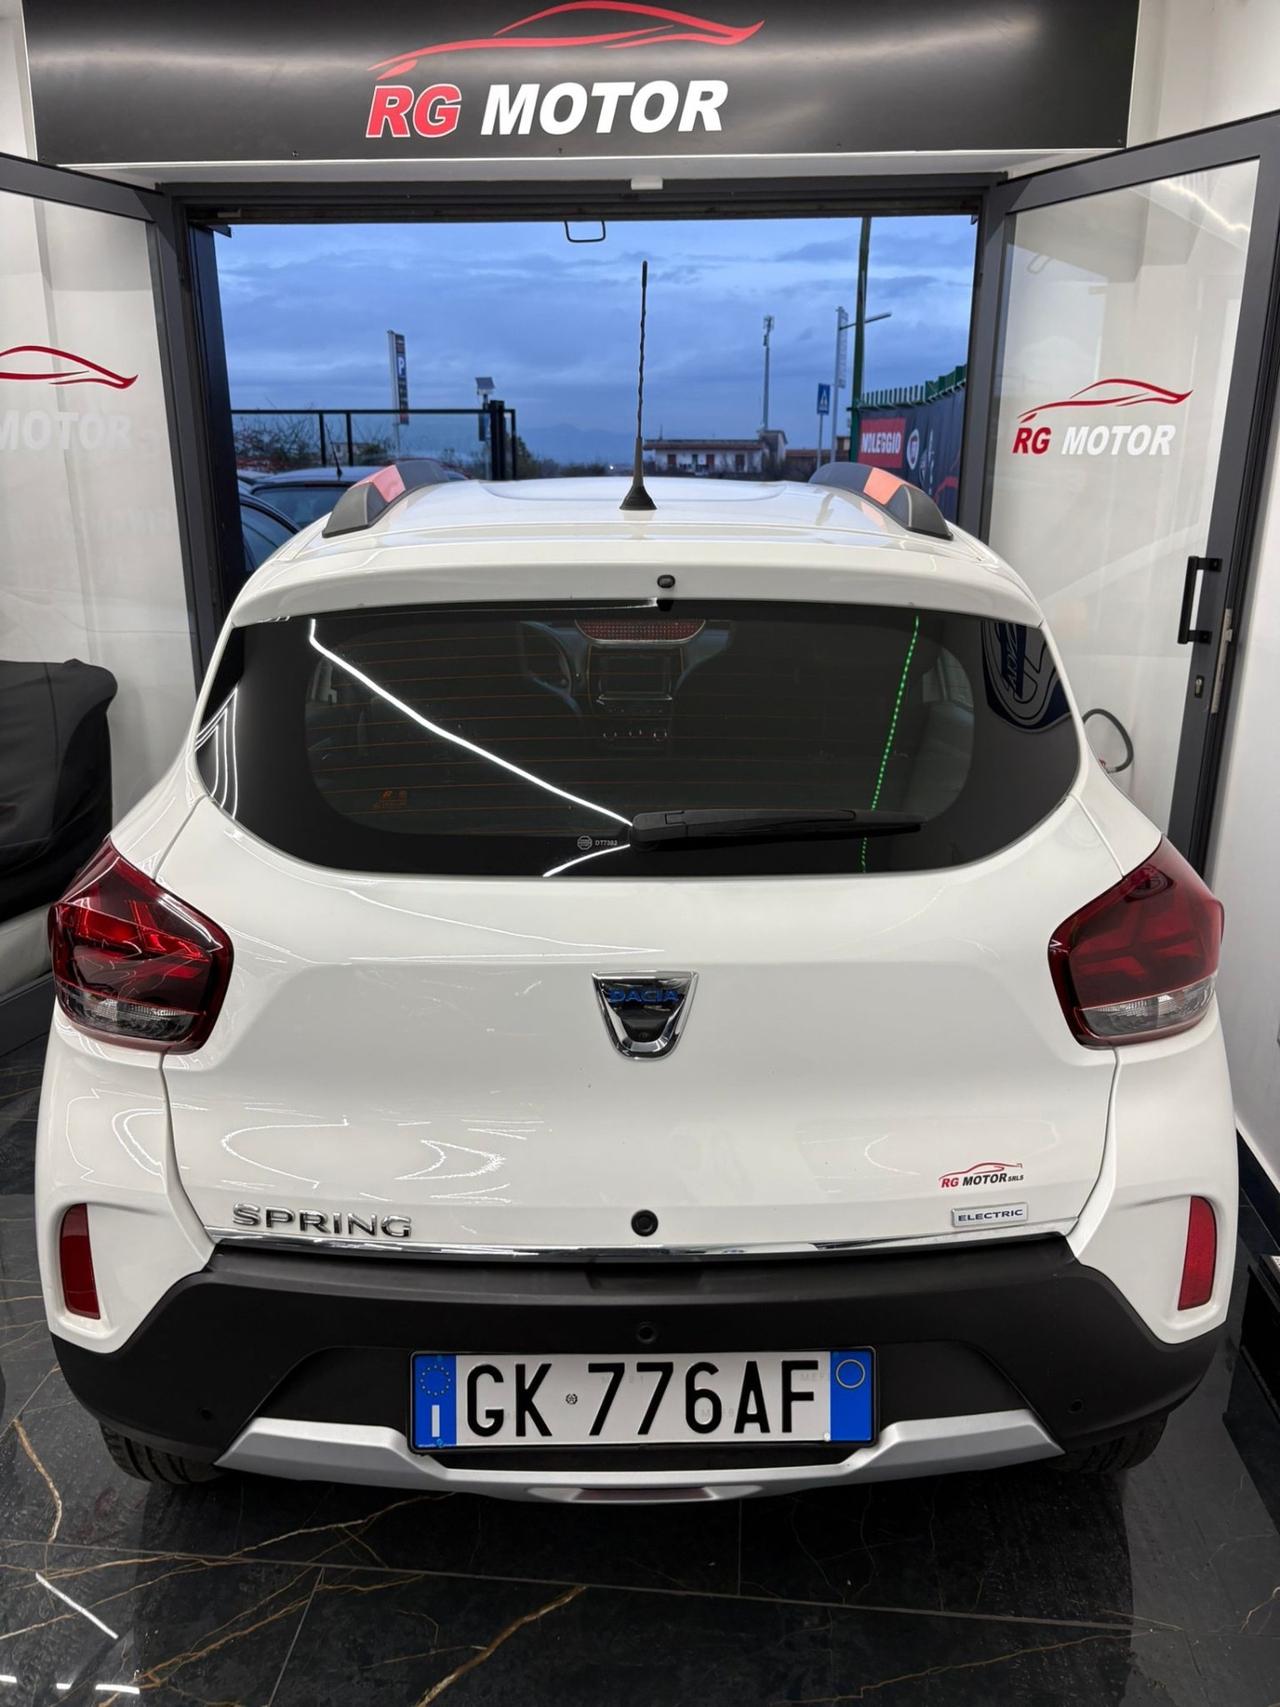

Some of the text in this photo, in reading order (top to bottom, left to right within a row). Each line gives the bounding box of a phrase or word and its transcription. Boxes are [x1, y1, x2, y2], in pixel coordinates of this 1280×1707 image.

[365, 79, 729, 138] RG MOTOR
[397, 357, 405, 374] P
[1012, 424, 1177, 456] RG MOTOR
[608, 990, 680, 1003] DACIA
[941, 1178, 959, 1188] RG
[962, 1173, 1008, 1186] MOTOR
[232, 1203, 412, 1237] SPRING
[958, 1210, 1024, 1222] ELECTRIC
[467, 1360, 819, 1437] GK 776AF
